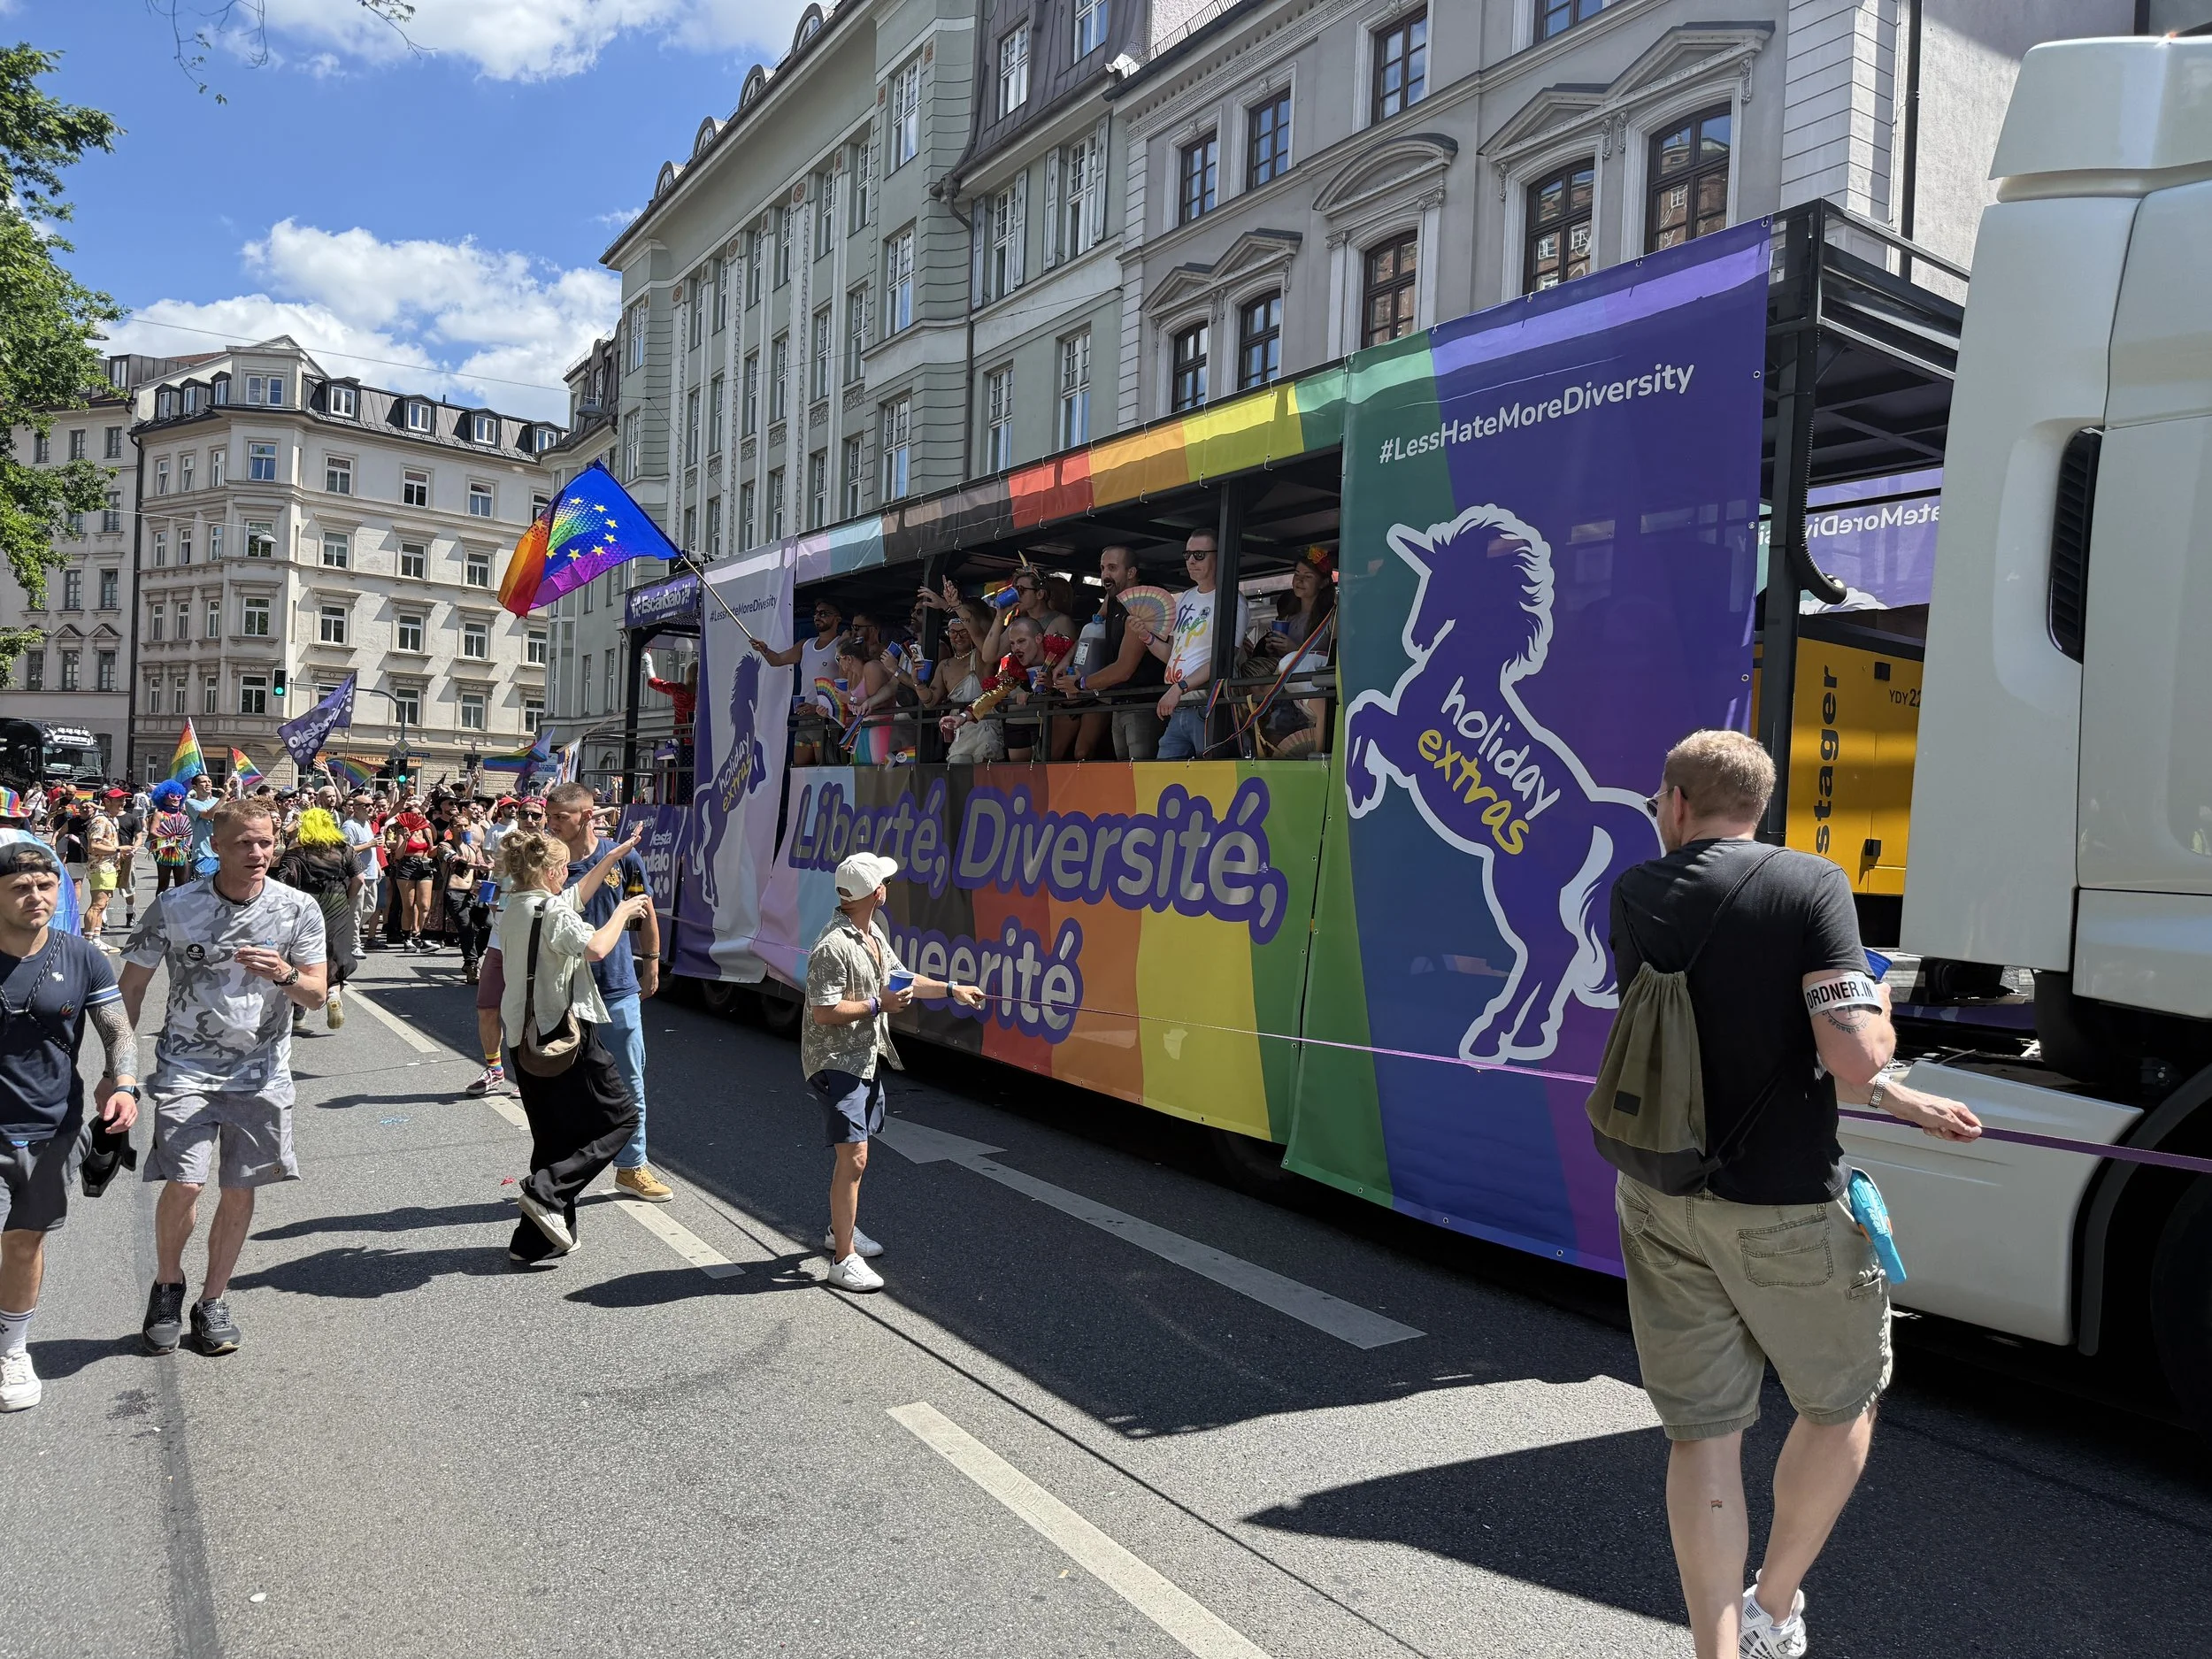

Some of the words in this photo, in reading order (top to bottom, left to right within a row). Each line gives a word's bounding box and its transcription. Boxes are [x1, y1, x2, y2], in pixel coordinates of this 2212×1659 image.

[1379, 362, 1695, 464] #LessHateMoreDiversity
[718, 732, 749, 795] holiday
[723, 753, 751, 812] extras
[1417, 728, 1530, 856] extras
[1440, 676, 1561, 821] holiday
[1814, 664, 1839, 855] stager
[795, 788, 947, 889] Liberté,
[958, 791, 1278, 928] Diversité,
[885, 917, 1077, 1031] ueerité
[1806, 980, 1874, 1010] ORDNER.IN
